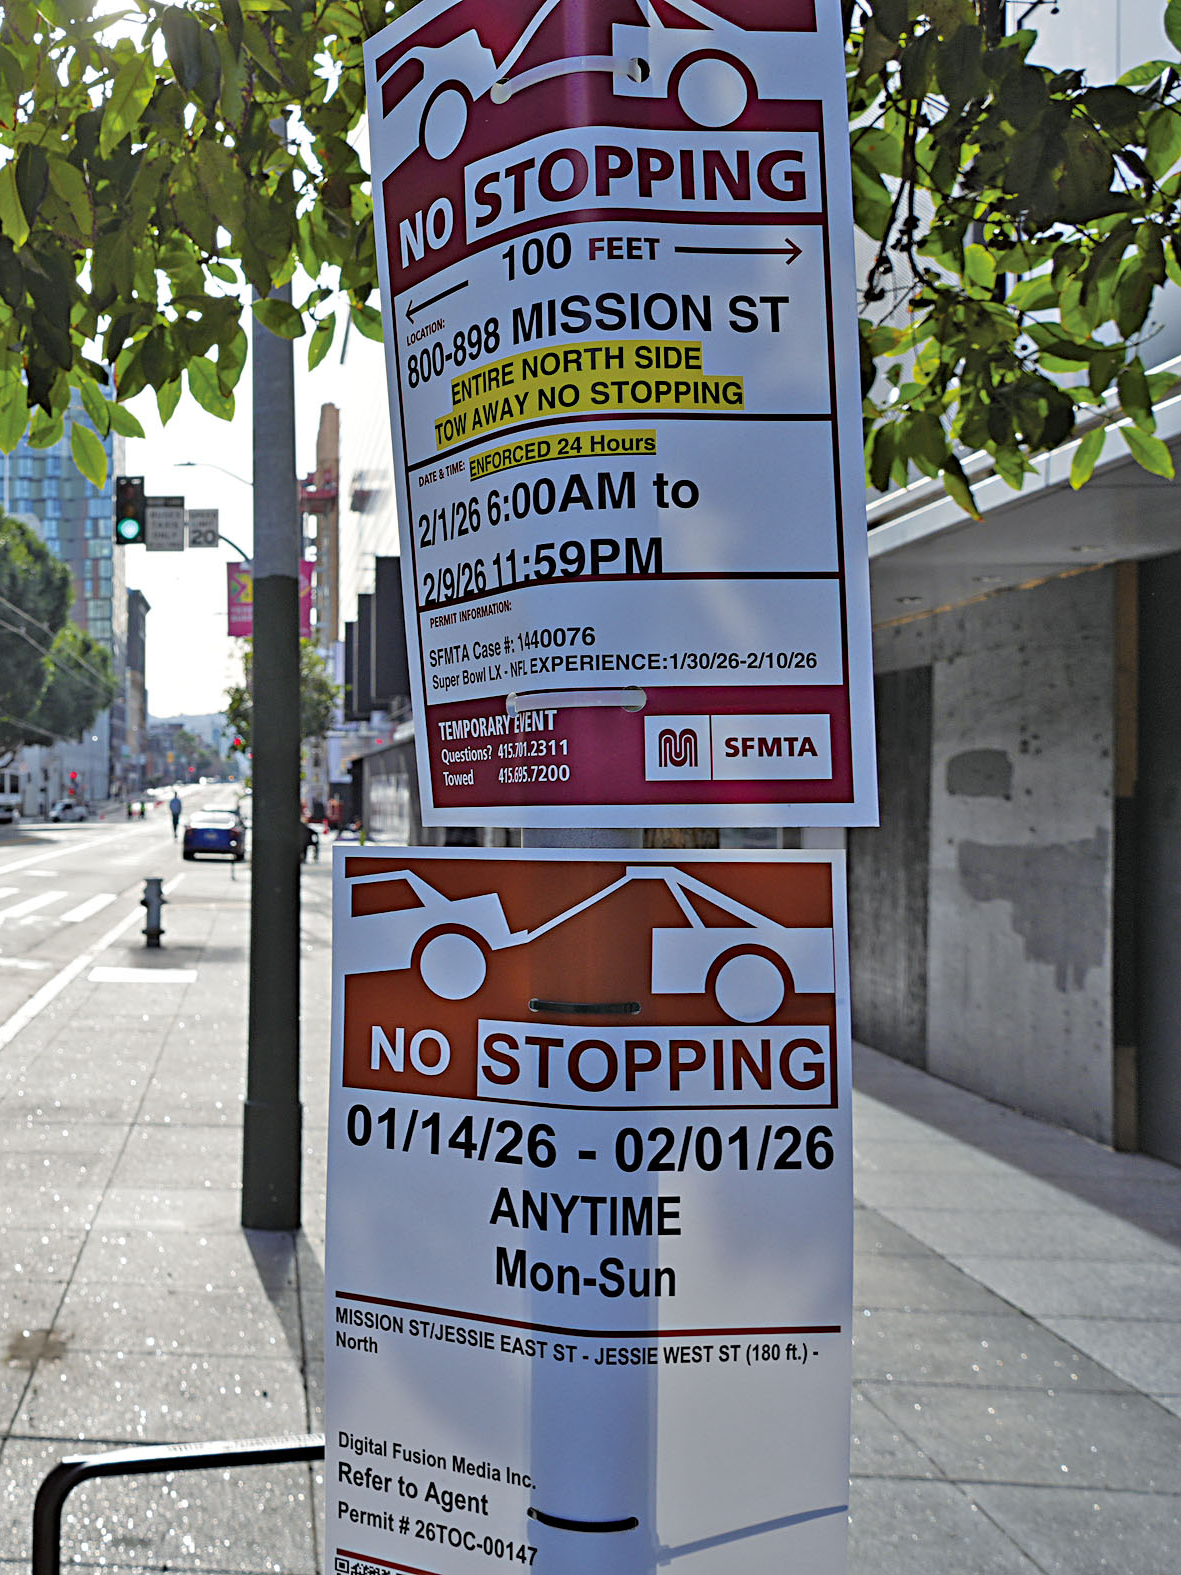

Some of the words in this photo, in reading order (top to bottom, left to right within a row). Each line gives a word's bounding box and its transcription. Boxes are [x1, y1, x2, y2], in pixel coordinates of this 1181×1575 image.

[399, 196, 454, 268] NO
[474, 145, 807, 229] STOPPING
[502, 232, 572, 282] 100
[588, 236, 660, 261] FEET
[406, 318, 446, 347] LOCATION:
[407, 317, 500, 389] 800-898
[512, 292, 712, 346] MISSION
[729, 295, 790, 333] ST
[451, 362, 514, 406] ENTIRE
[522, 346, 624, 381] NORTH
[634, 345, 702, 371] SIDE
[435, 412, 467, 445] TOW
[472, 392, 529, 431] AWAY
[538, 384, 580, 411] NO
[590, 380, 744, 405] STOPPING
[419, 470, 437, 487] DATE
[439, 468, 445, 479] &
[446, 461, 465, 477] TIME:
[469, 440, 551, 478] ENFORCED
[557, 436, 582, 456] 24
[589, 432, 656, 454] Hours
[419, 497, 481, 548] 2/1/26
[487, 471, 636, 526] 6:00AM
[653, 473, 700, 510] to
[191, 529, 216, 545] 20
[423, 558, 487, 606] 2/9/26
[493, 537, 664, 587] 11:59PM
[430, 612, 457, 629] PERMIT
[459, 600, 512, 623] INFORMATION:
[429, 644, 470, 668] SFMTA
[473, 640, 501, 660] Case
[504, 636, 515, 654] #:
[517, 626, 596, 652] 1440076
[432, 671, 460, 691] Super
[462, 667, 486, 685] Bowl
[489, 664, 502, 681] LX
[510, 660, 528, 678] NFL
[530, 652, 818, 675] EXPERIENCE:1/30/26-2/10/26
[438, 714, 511, 741] TEMPORARY
[514, 709, 558, 734] EVENT
[724, 736, 819, 758] SFMTA
[441, 744, 493, 765] Questions?
[498, 739, 568, 759] 415.701.2311
[443, 769, 474, 786] Towed
[498, 764, 571, 784] 415.695.7200
[370, 1025, 451, 1076] NO
[481, 1033, 826, 1093] STOPPING
[347, 1104, 557, 1169] 01/14/26
[578, 1150, 596, 1160] -
[615, 1124, 834, 1172] 02/01/26
[489, 1187, 682, 1237] ANYTIME
[495, 1247, 676, 1298] Mon-Sun
[336, 1307, 404, 1334] MISSION
[409, 1319, 495, 1350] ST/JESSIE
[500, 1334, 548, 1359] EAST
[553, 1344, 577, 1363] ST
[595, 1347, 658, 1366] JESSIE
[663, 1345, 714, 1364] WEST
[719, 1344, 741, 1362] ST
[746, 1343, 780, 1366] (180
[785, 1342, 808, 1365] ft.)
[336, 1330, 378, 1354] North
[339, 1431, 387, 1457] Digital
[393, 1442, 447, 1470] Fusion
[452, 1455, 501, 1482] Media
[506, 1467, 537, 1490] Inc.
[338, 1461, 392, 1493] Refer
[398, 1475, 418, 1499] to
[424, 1481, 489, 1516] Agent
[338, 1500, 394, 1532] Permit
[399, 1515, 410, 1535] #
[415, 1519, 538, 1566] 26TOC-00147
